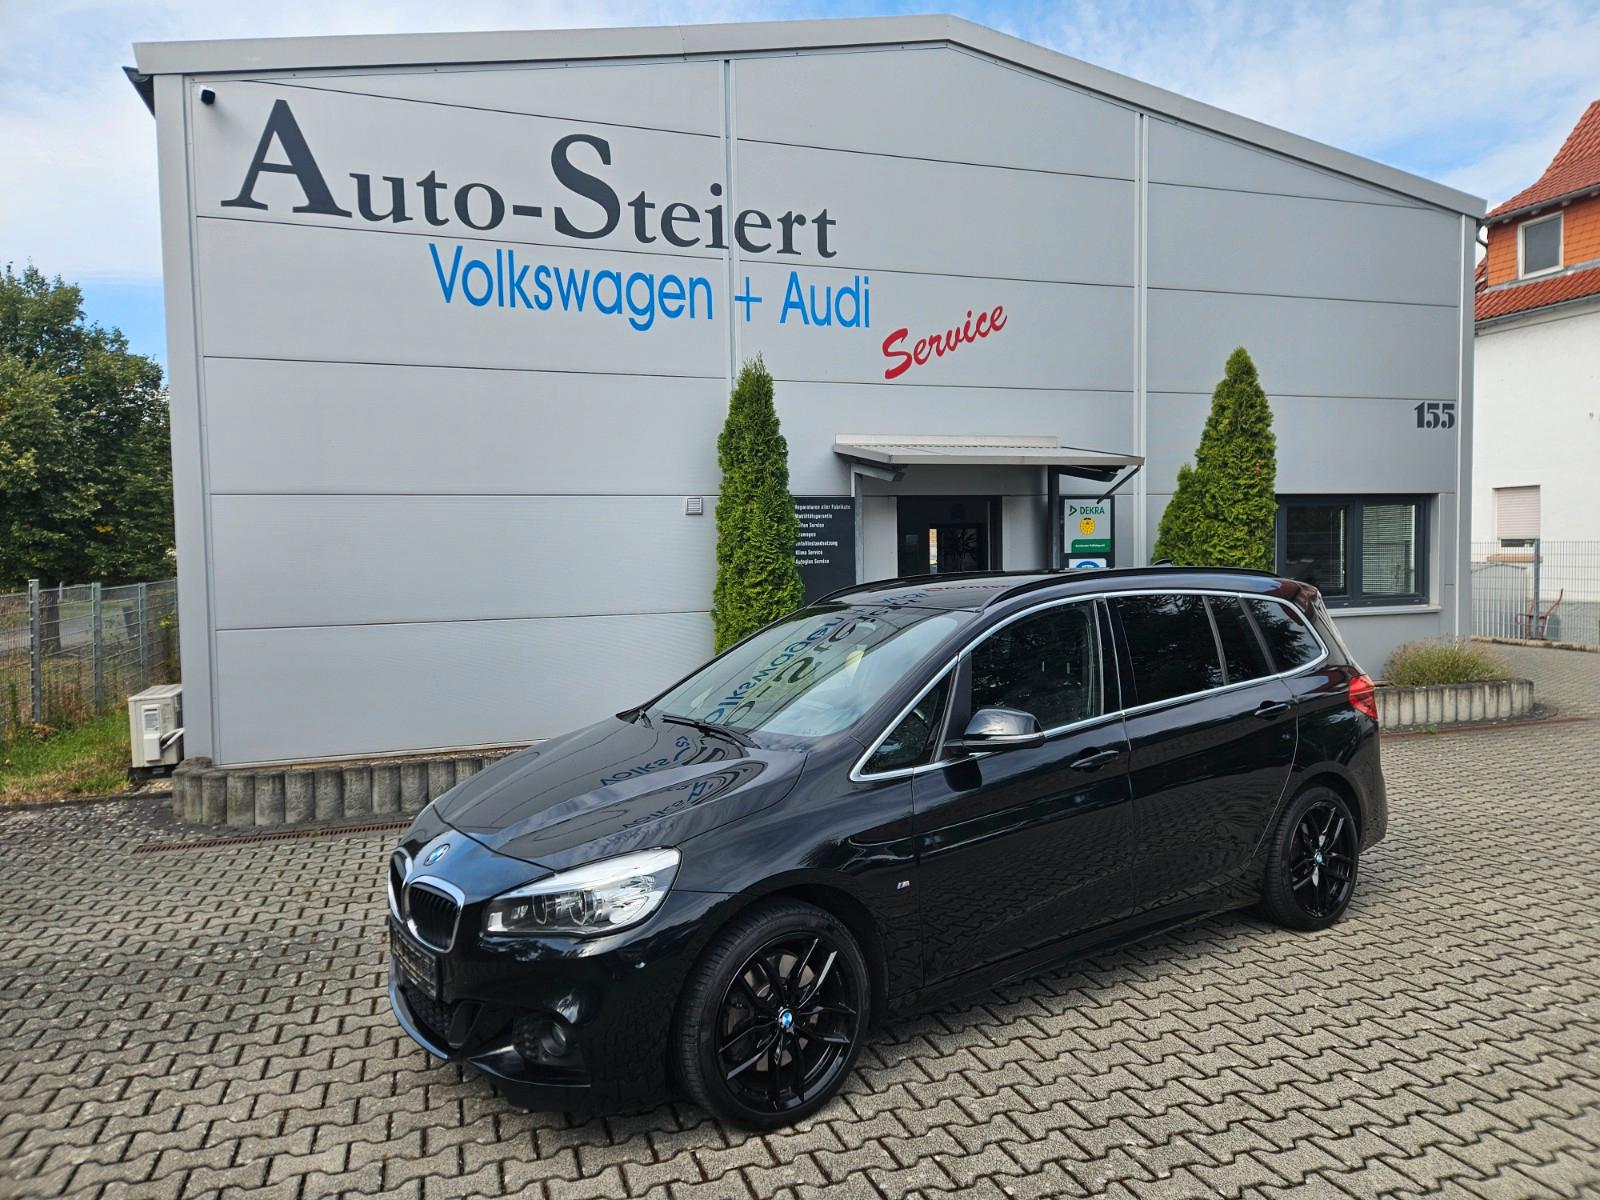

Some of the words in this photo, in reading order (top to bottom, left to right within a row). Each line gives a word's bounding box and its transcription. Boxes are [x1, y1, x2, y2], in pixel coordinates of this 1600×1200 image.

[221, 99, 838, 259] Auto-Steiert
[428, 243, 713, 332] Volkswagen
[779, 271, 871, 328] Audi
[882, 305, 1007, 379] Service
[1414, 400, 1456, 429] 155
[1079, 506, 1105, 515] DEKRA
